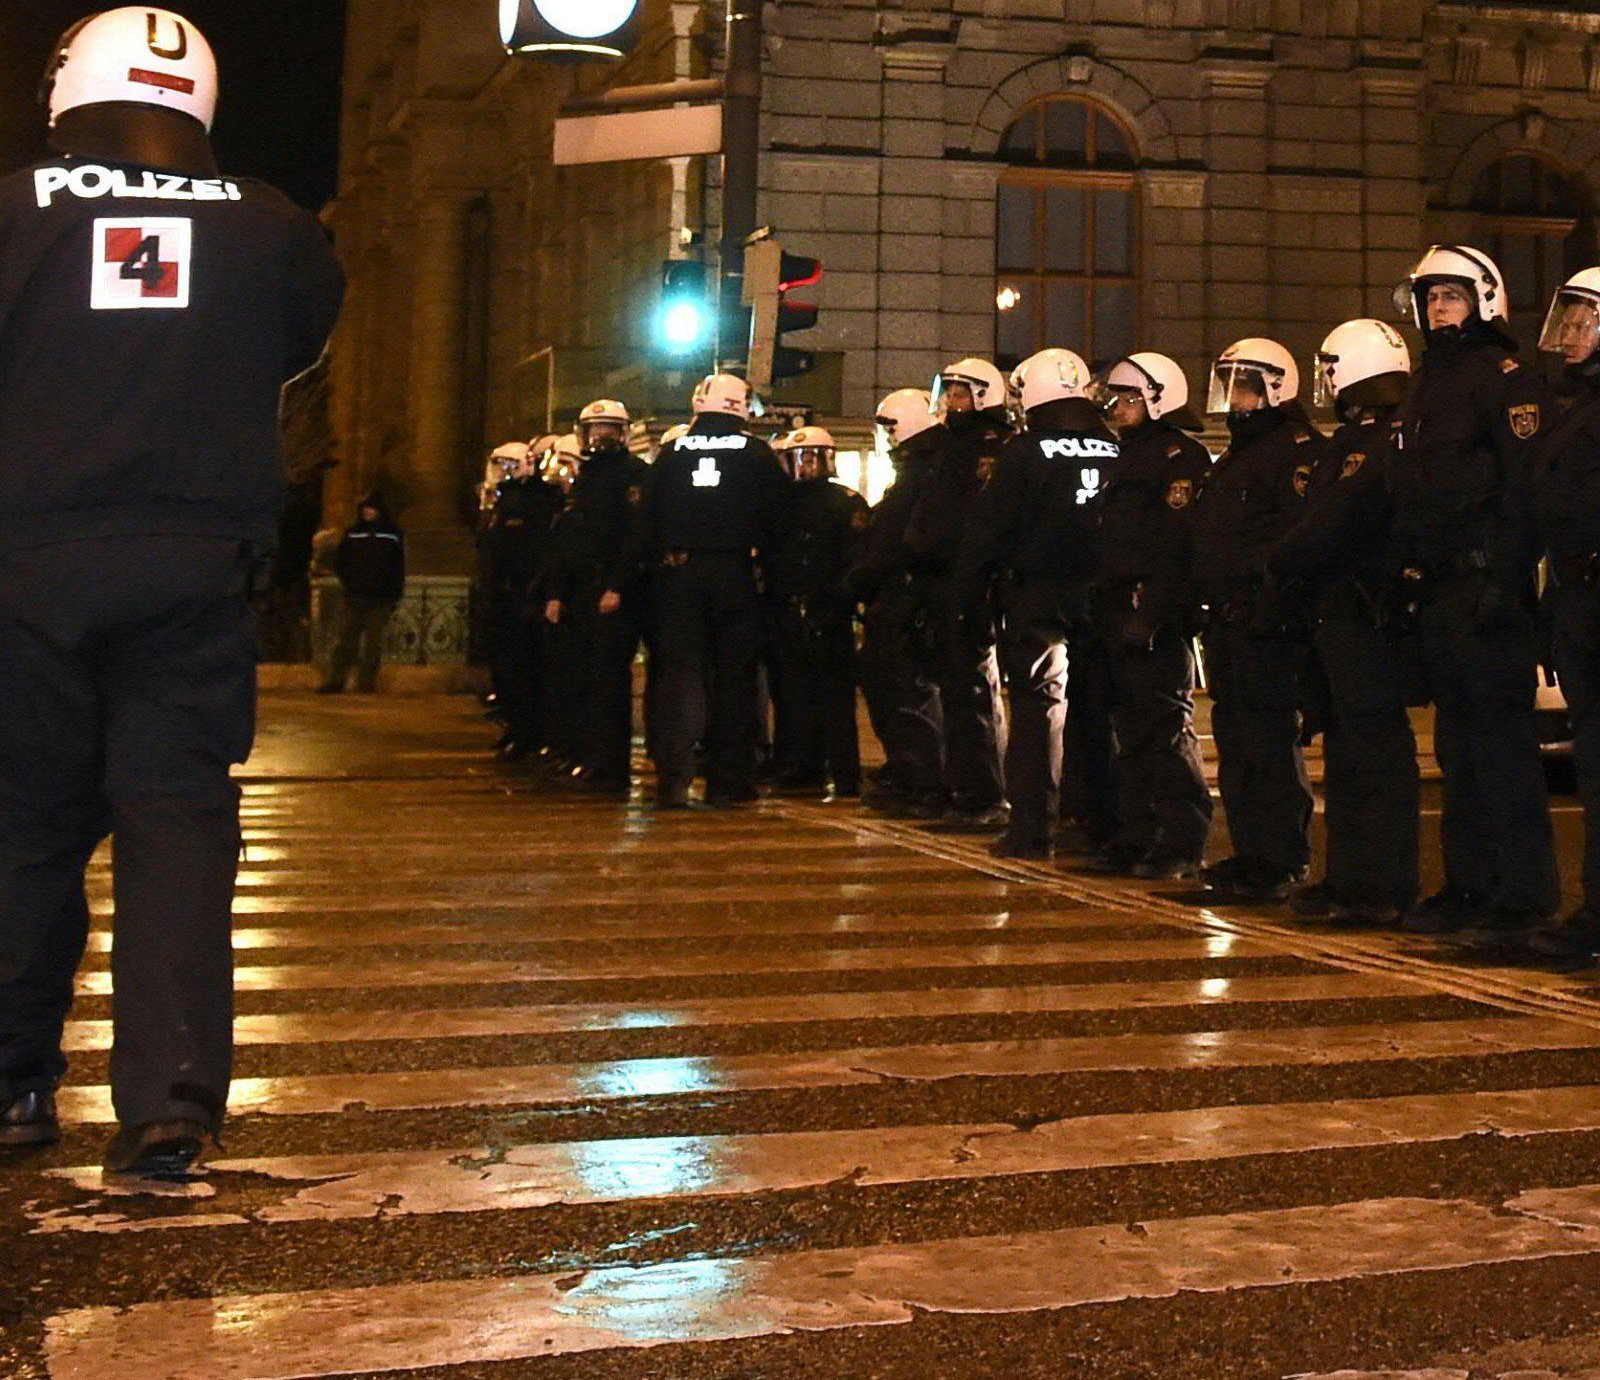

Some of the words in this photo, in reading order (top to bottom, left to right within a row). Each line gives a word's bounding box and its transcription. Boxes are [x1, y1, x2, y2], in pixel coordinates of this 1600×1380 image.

[146, 12, 187, 60] U
[34, 164, 242, 208] POLIZEI
[120, 235, 165, 290] 4
